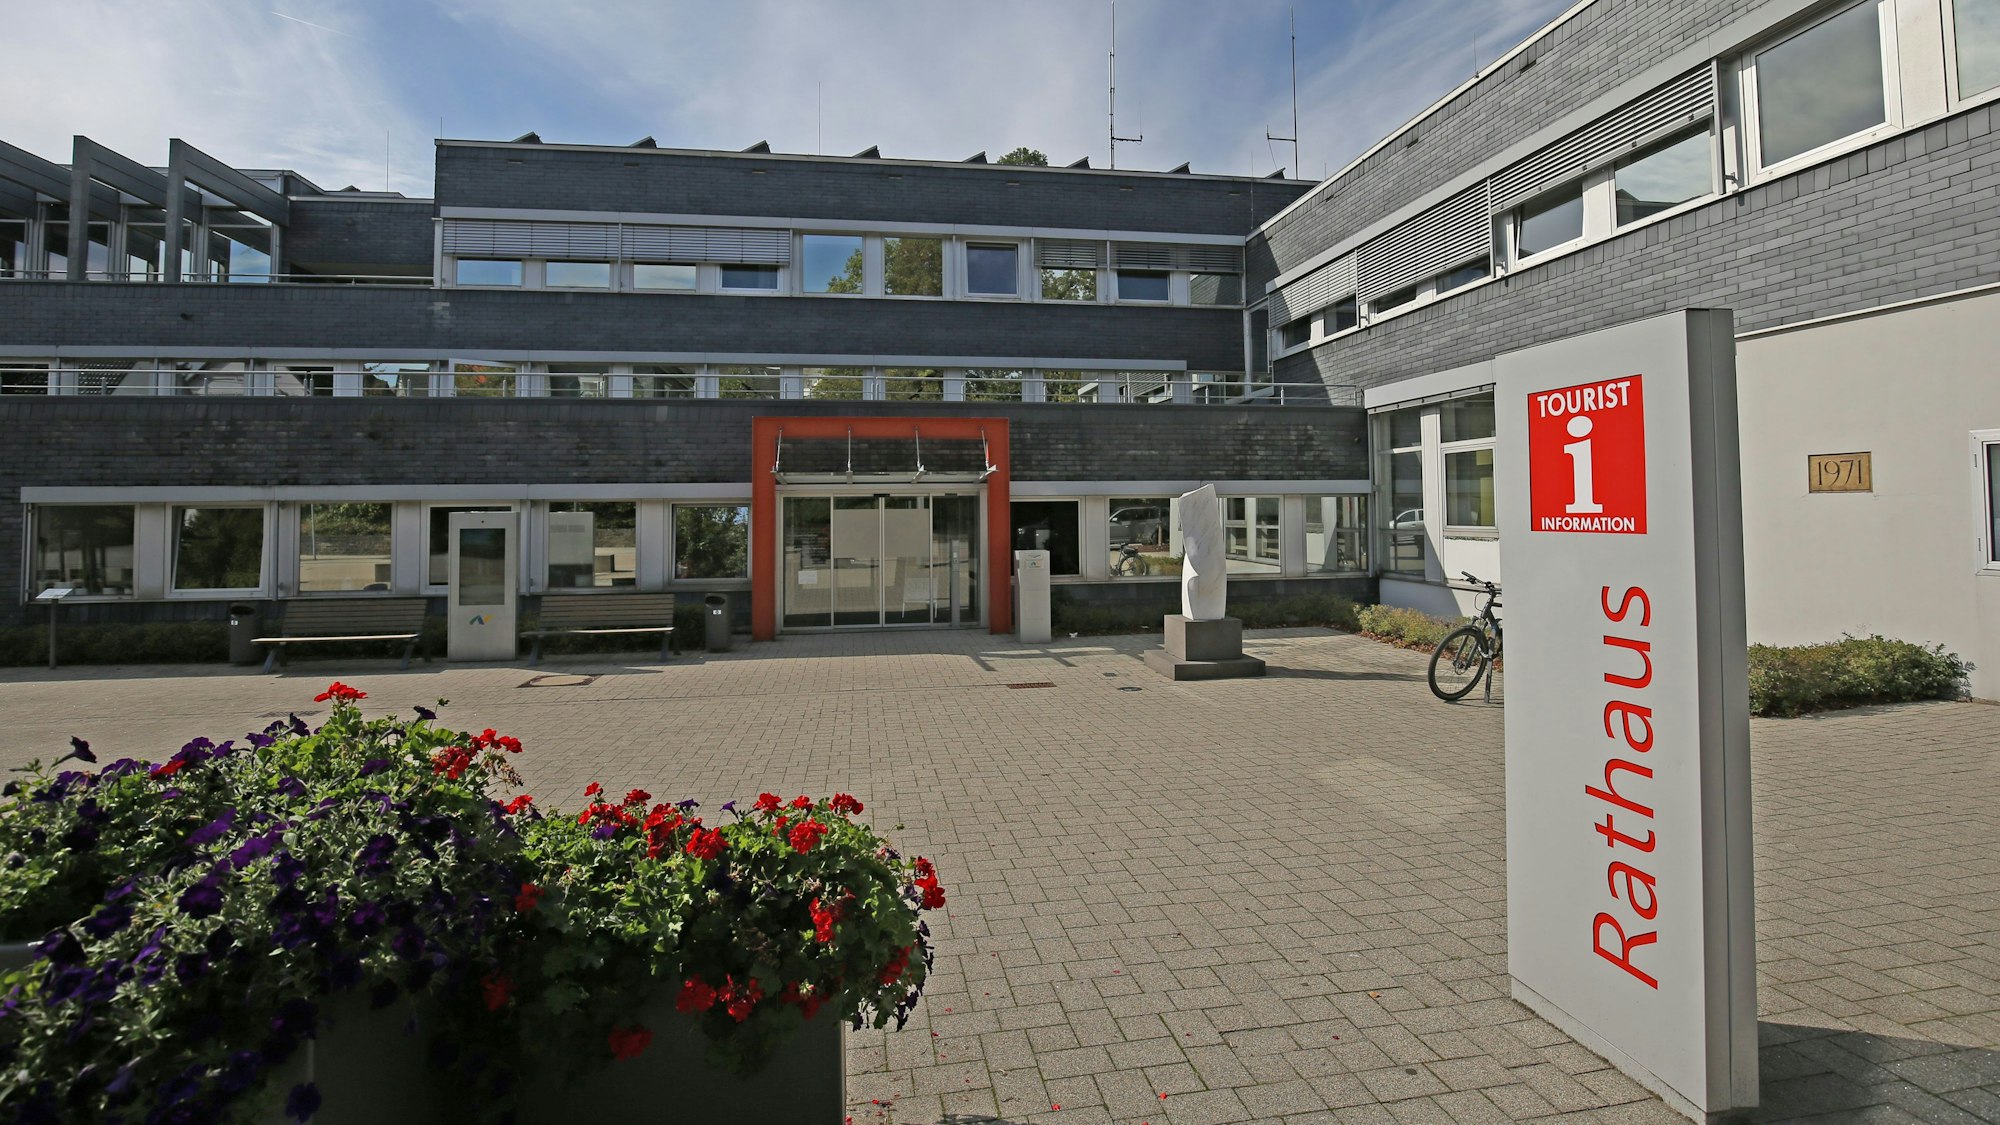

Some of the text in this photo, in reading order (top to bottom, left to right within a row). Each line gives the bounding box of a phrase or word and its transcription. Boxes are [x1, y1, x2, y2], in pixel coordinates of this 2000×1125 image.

[1537, 381, 1631, 418] TOURIST
[1563, 415, 1603, 513] i
[1817, 459, 1862, 487] 1971
[1541, 516, 1635, 531] INFORMATION
[1584, 585, 1658, 990] Rathaus
